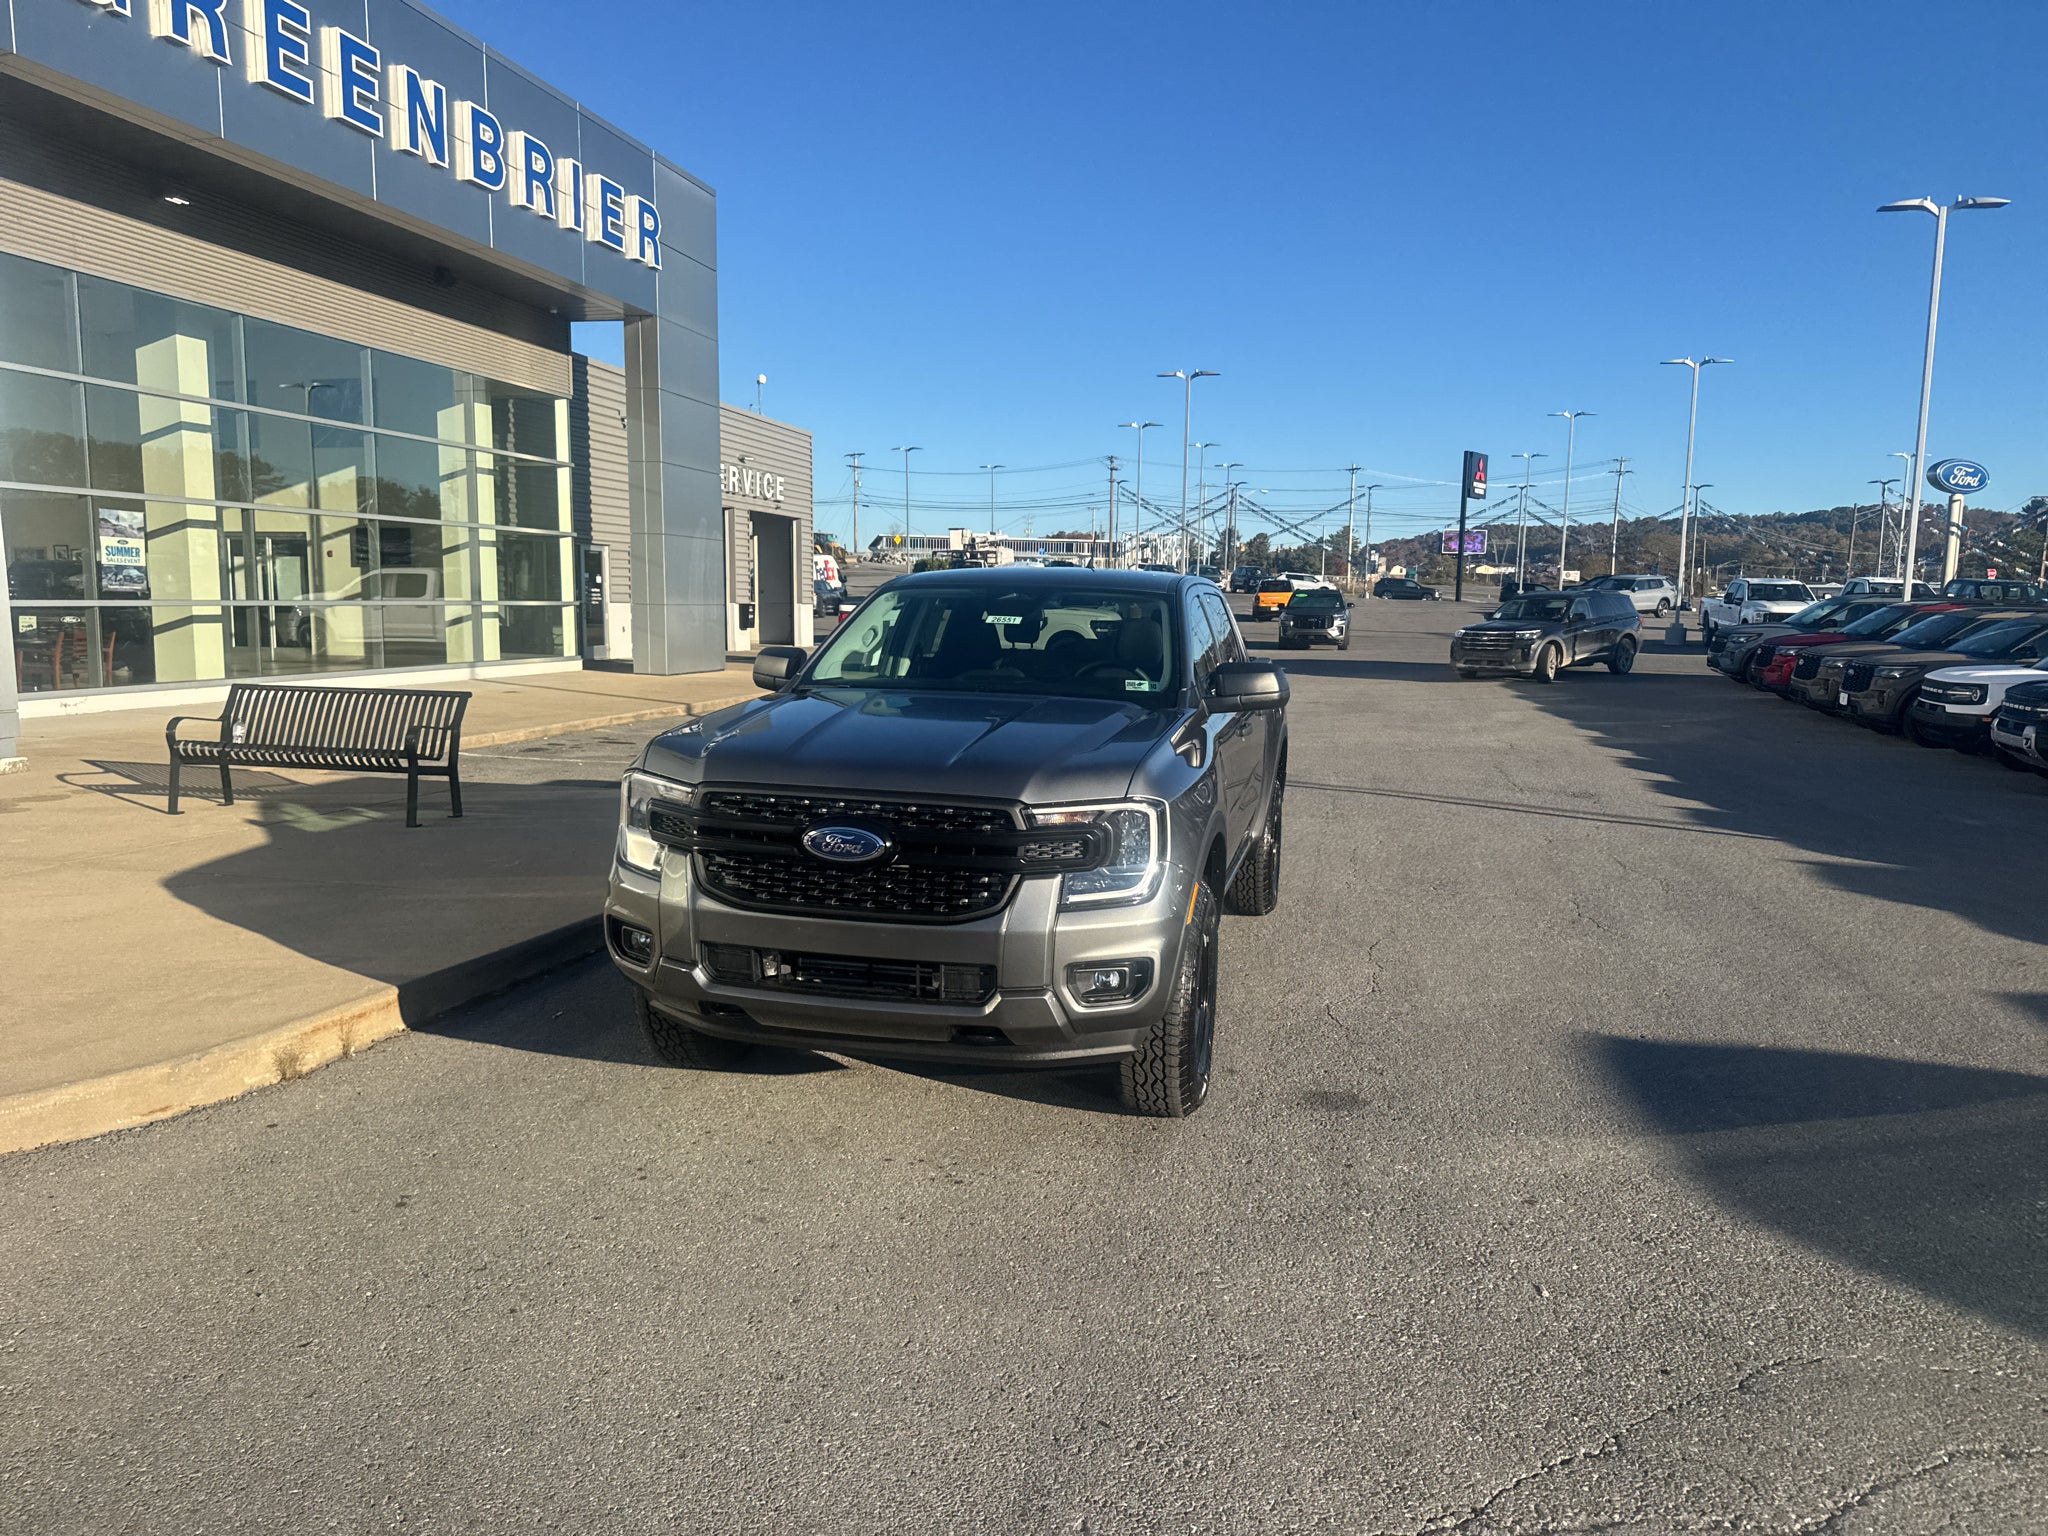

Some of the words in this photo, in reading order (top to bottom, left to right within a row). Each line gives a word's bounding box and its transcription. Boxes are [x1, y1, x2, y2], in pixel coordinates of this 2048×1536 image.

[78, 0, 664, 271] REENBRIER
[1949, 465, 1982, 487] Ford
[105, 545, 141, 558] SUMMER
[821, 833, 865, 855] Ford
